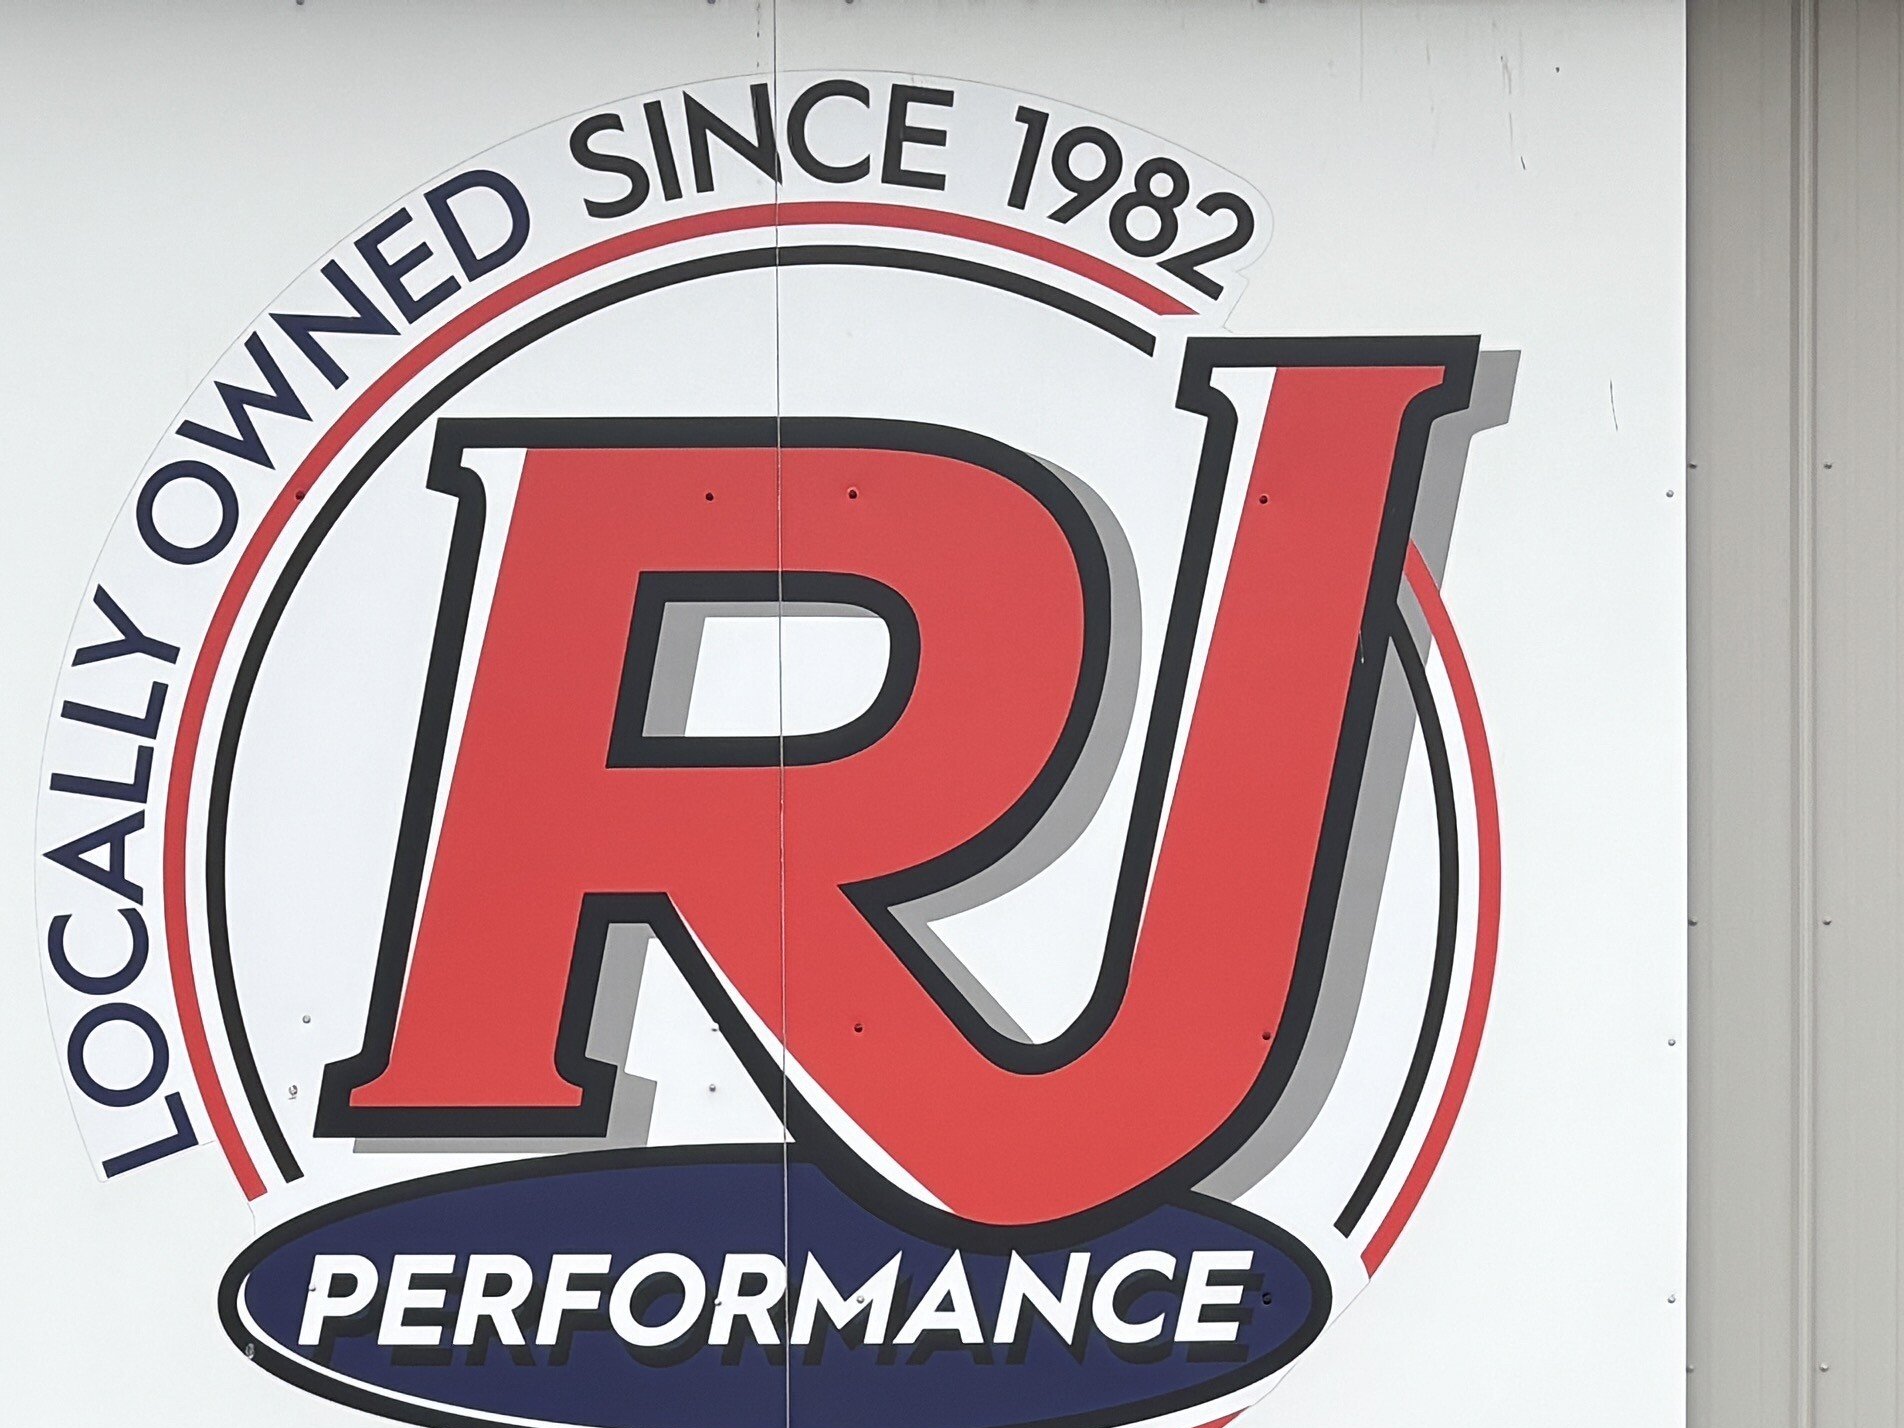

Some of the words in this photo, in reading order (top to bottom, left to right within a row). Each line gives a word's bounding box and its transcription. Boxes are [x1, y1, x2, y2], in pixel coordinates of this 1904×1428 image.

[46, 584, 198, 1180] LOCALLY
[136, 169, 531, 566] OWNED
[569, 79, 955, 219] SINCE
[1007, 105, 1256, 302] 1982
[312, 334, 1482, 1252] RJ
[297, 1249, 1255, 1348] PERFORMANCE
